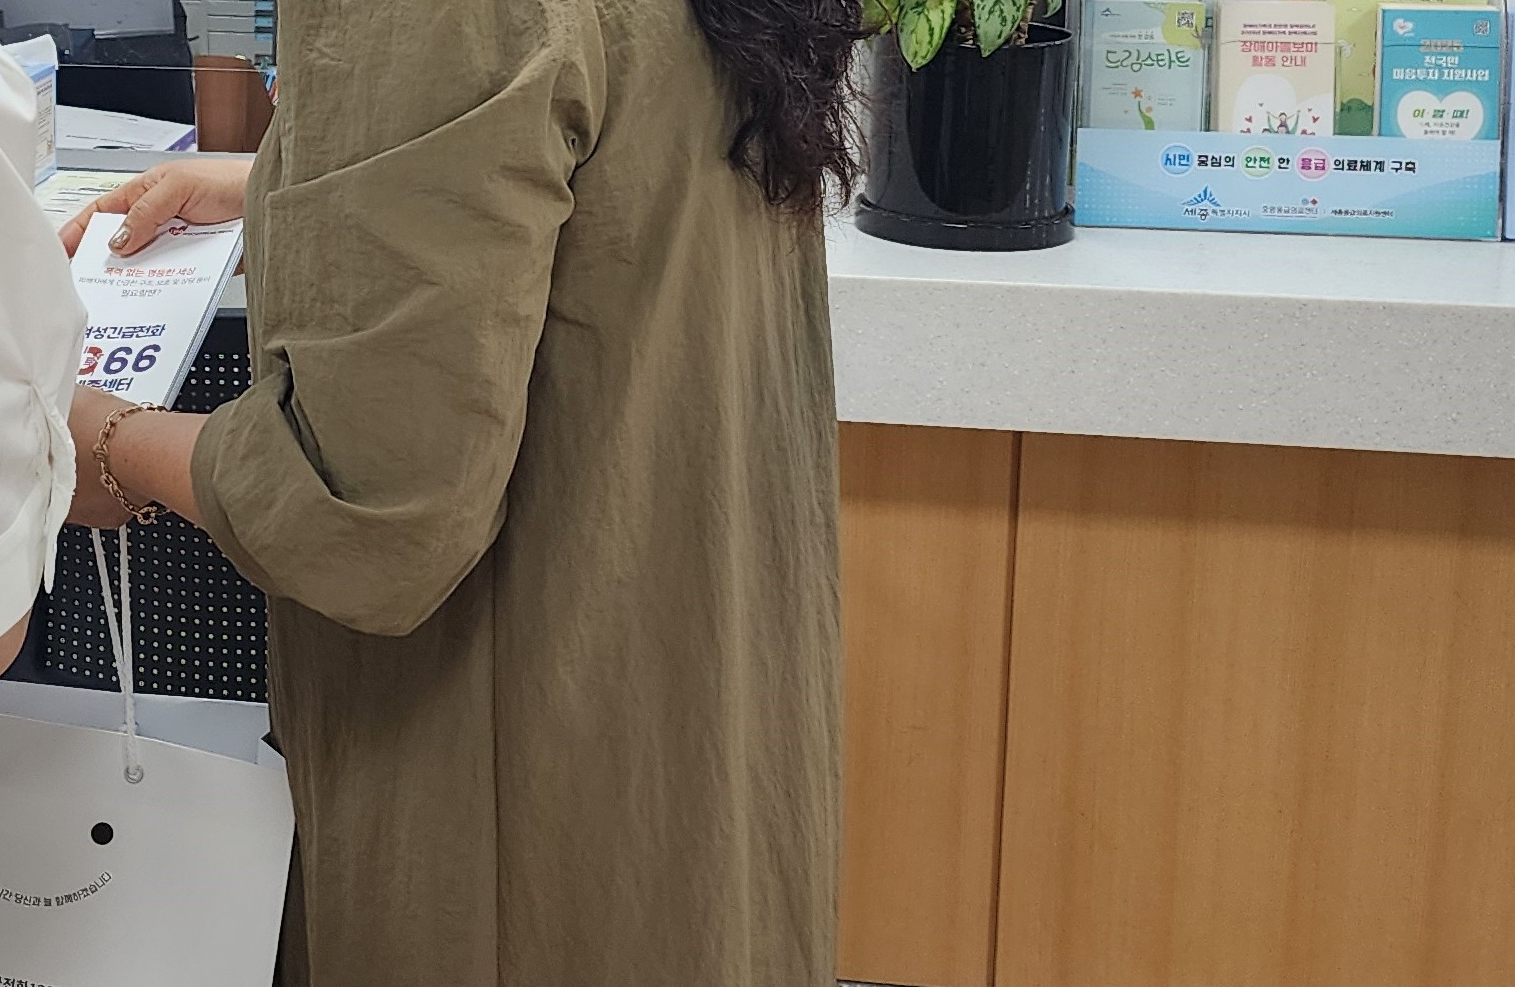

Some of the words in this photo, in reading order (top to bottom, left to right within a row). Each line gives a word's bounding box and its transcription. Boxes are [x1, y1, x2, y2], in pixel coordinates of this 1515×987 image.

[1105, 48, 1191, 72] 드림스타트
[1281, 55, 1306, 67] 안내
[1423, 55, 1460, 67] 전국민
[1165, 153, 1191, 167] 시민
[1197, 154, 1235, 168] 중심의
[1245, 156, 1271, 170] 안전
[1277, 156, 1291, 170] 한
[1301, 157, 1326, 171] 응급
[1333, 158, 1385, 173] 의료체계
[1390, 159, 1417, 174] 구축
[14, 893, 42, 907] 당신과
